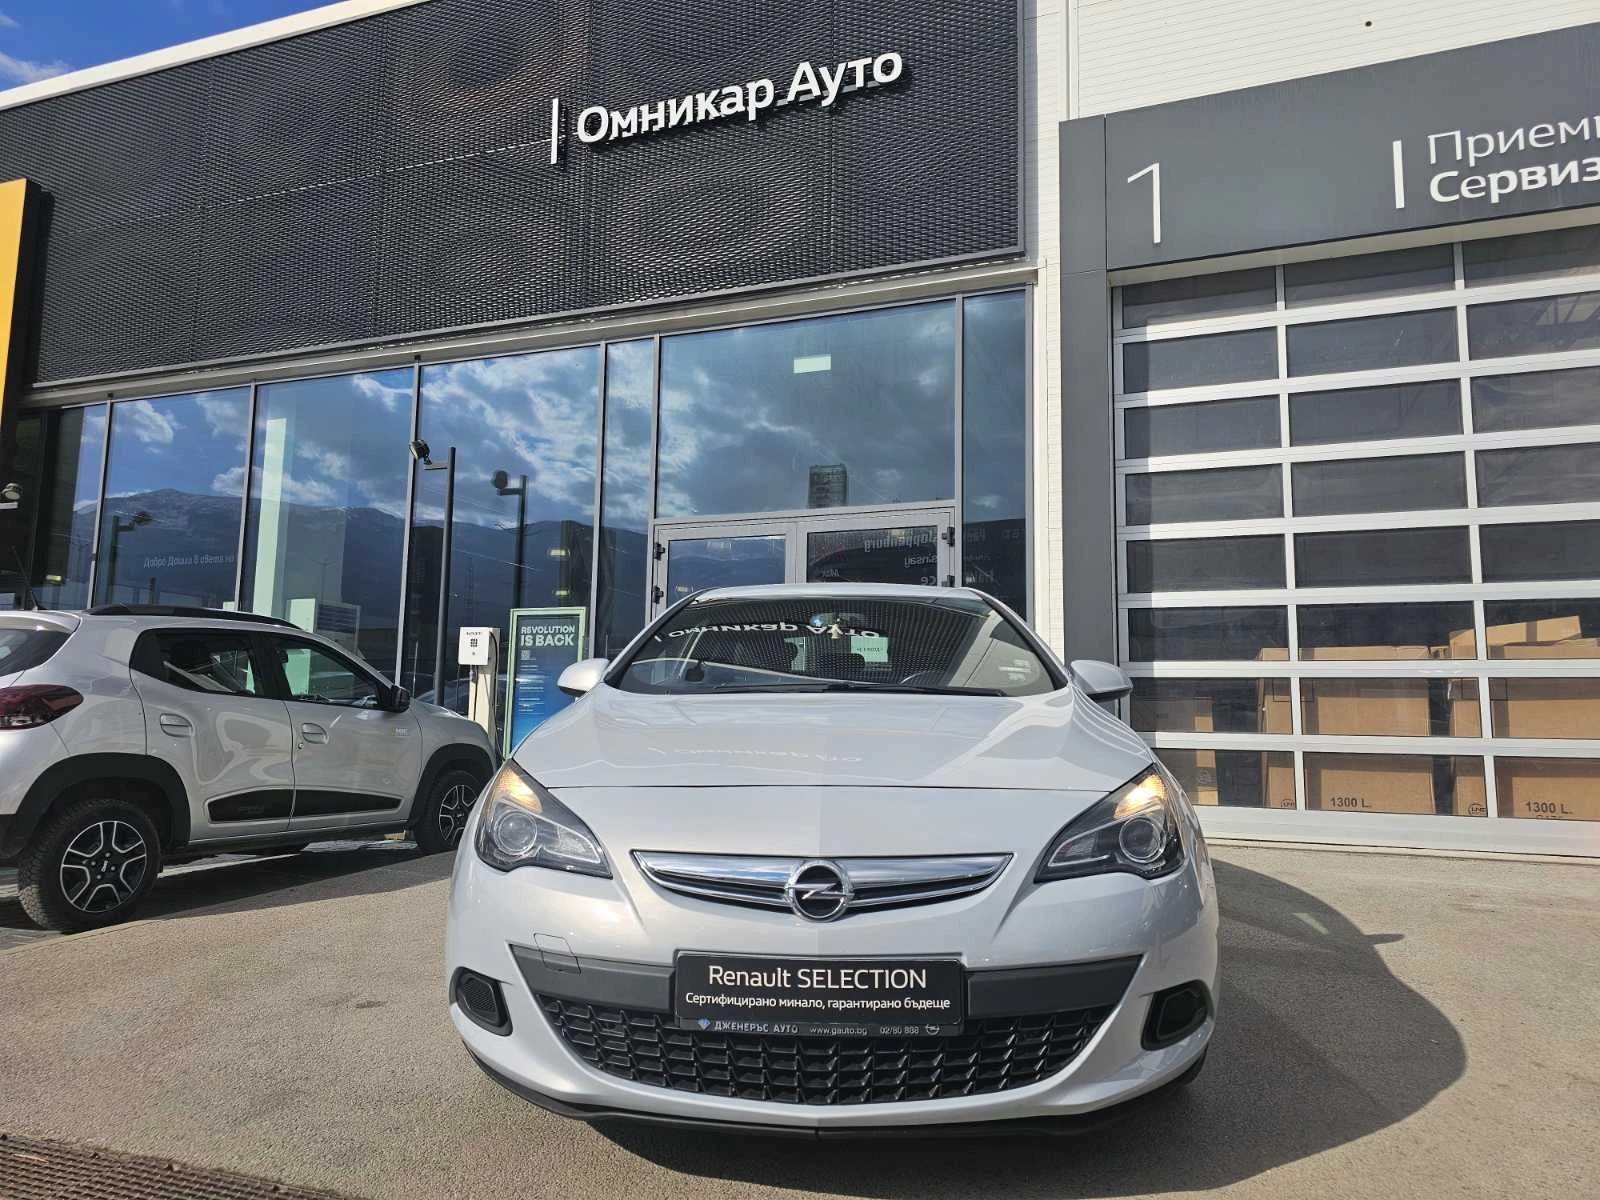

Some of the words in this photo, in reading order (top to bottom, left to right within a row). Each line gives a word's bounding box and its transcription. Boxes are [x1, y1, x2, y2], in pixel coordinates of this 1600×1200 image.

[576, 78, 775, 143] Омникар
[786, 51, 902, 107] Ауто
[1429, 156, 1600, 204] Сервиз
[1127, 162, 1161, 244] 1
[521, 625, 575, 634] REVOLUTION
[520, 634, 533, 647] IS
[535, 634, 574, 646] BACK
[1330, 796, 1358, 808] 1300
[1525, 801, 1556, 814] 1300
[708, 965, 791, 988] Renault
[797, 968, 927, 989] SELECTION
[686, 992, 777, 1009] Сертифицирано
[779, 997, 826, 1010] минало,
[827, 998, 902, 1011] гарантирано
[904, 997, 951, 1010] бъдеще
[773, 1023, 799, 1034] АУТО
